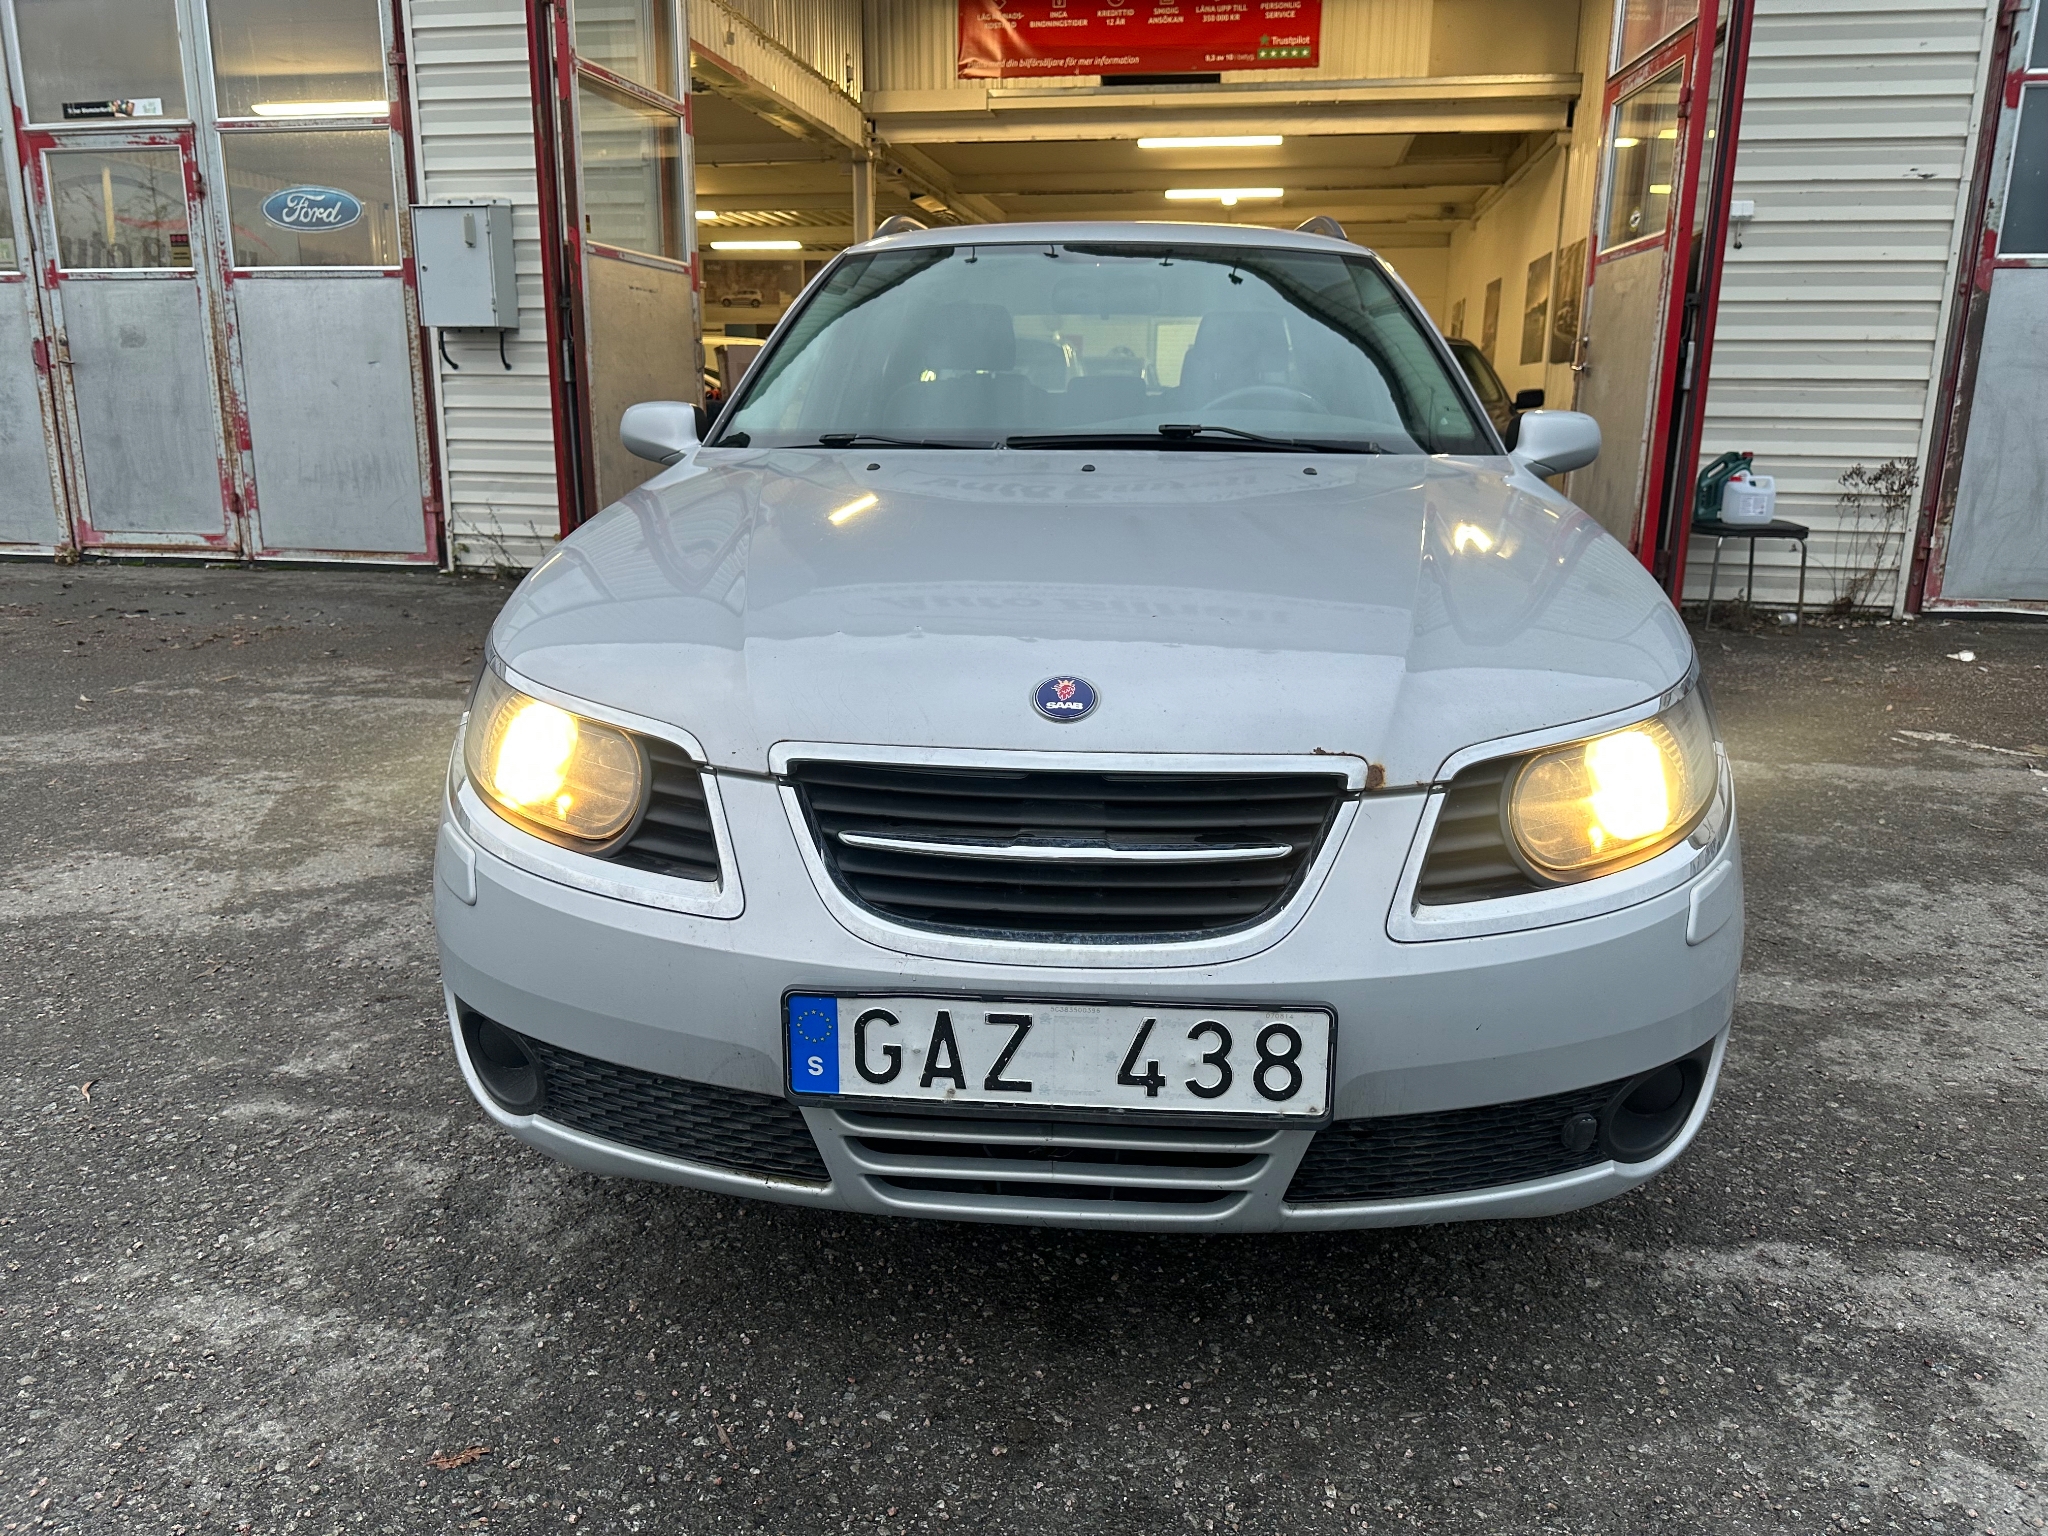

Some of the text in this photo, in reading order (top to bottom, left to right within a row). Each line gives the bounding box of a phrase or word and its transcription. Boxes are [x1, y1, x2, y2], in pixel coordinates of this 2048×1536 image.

[1148, 15, 1184, 24] ANSÖKAN
[1265, 10, 1296, 19] SERVICE
[1272, 35, 1310, 45] Trustpilot
[1093, 56, 1140, 66] information
[281, 193, 342, 224] Ford
[1046, 701, 1083, 710] SAAB
[854, 1007, 1303, 1102] GAZ 438
[807, 1056, 824, 1076] S
